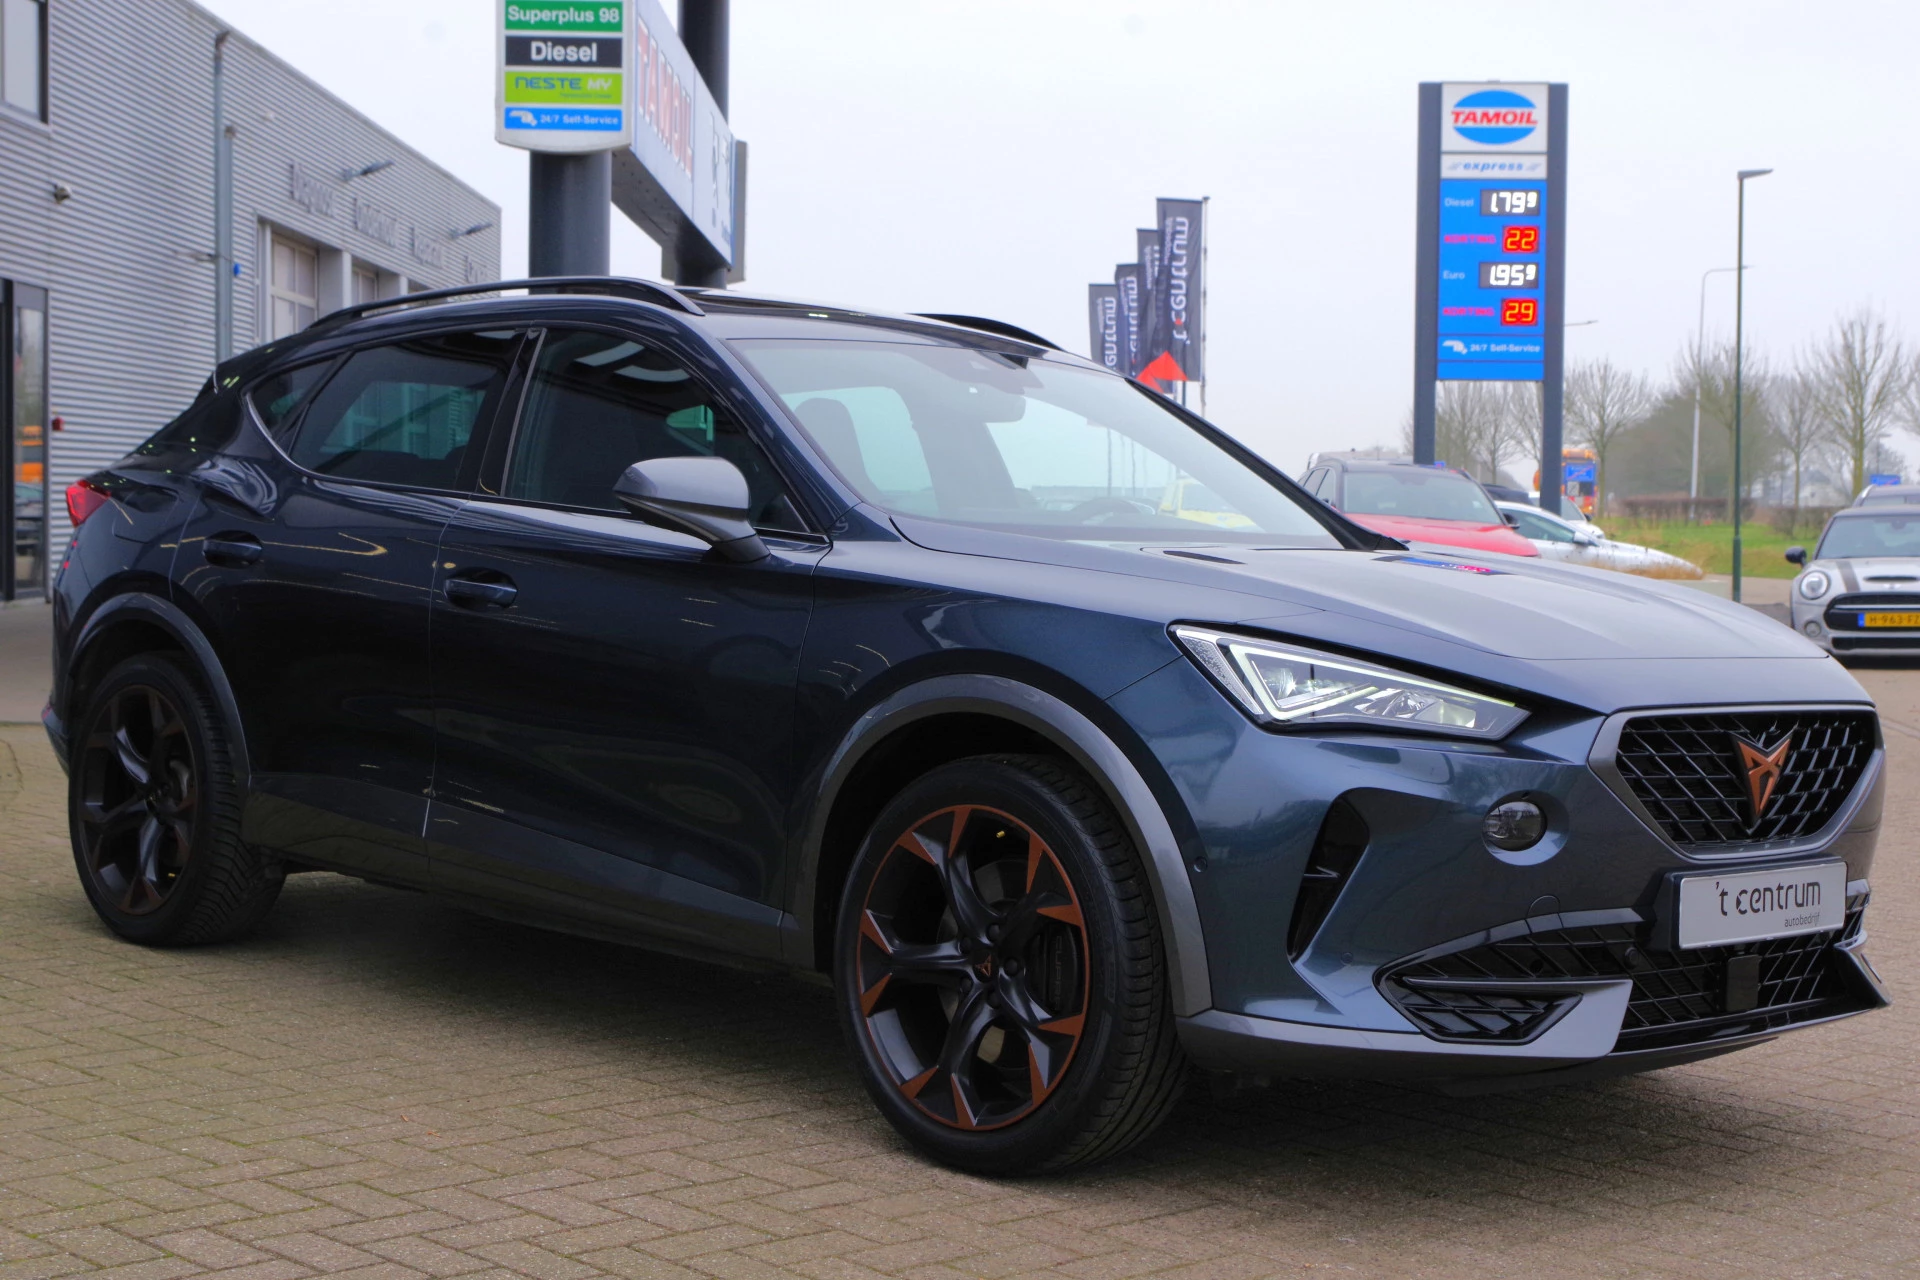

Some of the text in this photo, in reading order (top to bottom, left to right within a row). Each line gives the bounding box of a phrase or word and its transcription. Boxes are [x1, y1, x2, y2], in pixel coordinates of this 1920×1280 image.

[507, 4, 621, 24] Superplus 98
[530, 41, 597, 62] Diesel
[587, 78, 612, 91] MY
[637, 14, 693, 182] TAMOIL
[540, 114, 619, 125] 24/7 Self-Service
[1451, 110, 1538, 126] TAMOIL
[1462, 161, 1524, 173] express
[1444, 197, 1475, 207] Diesel
[1506, 229, 1536, 250] 22
[1442, 270, 1466, 280] Euro
[1504, 301, 1534, 322] 29
[1470, 343, 1541, 354] 24/7 Self-Service
[1735, 881, 1821, 915] centrum
[1784, 913, 1820, 928] autobedrijf
